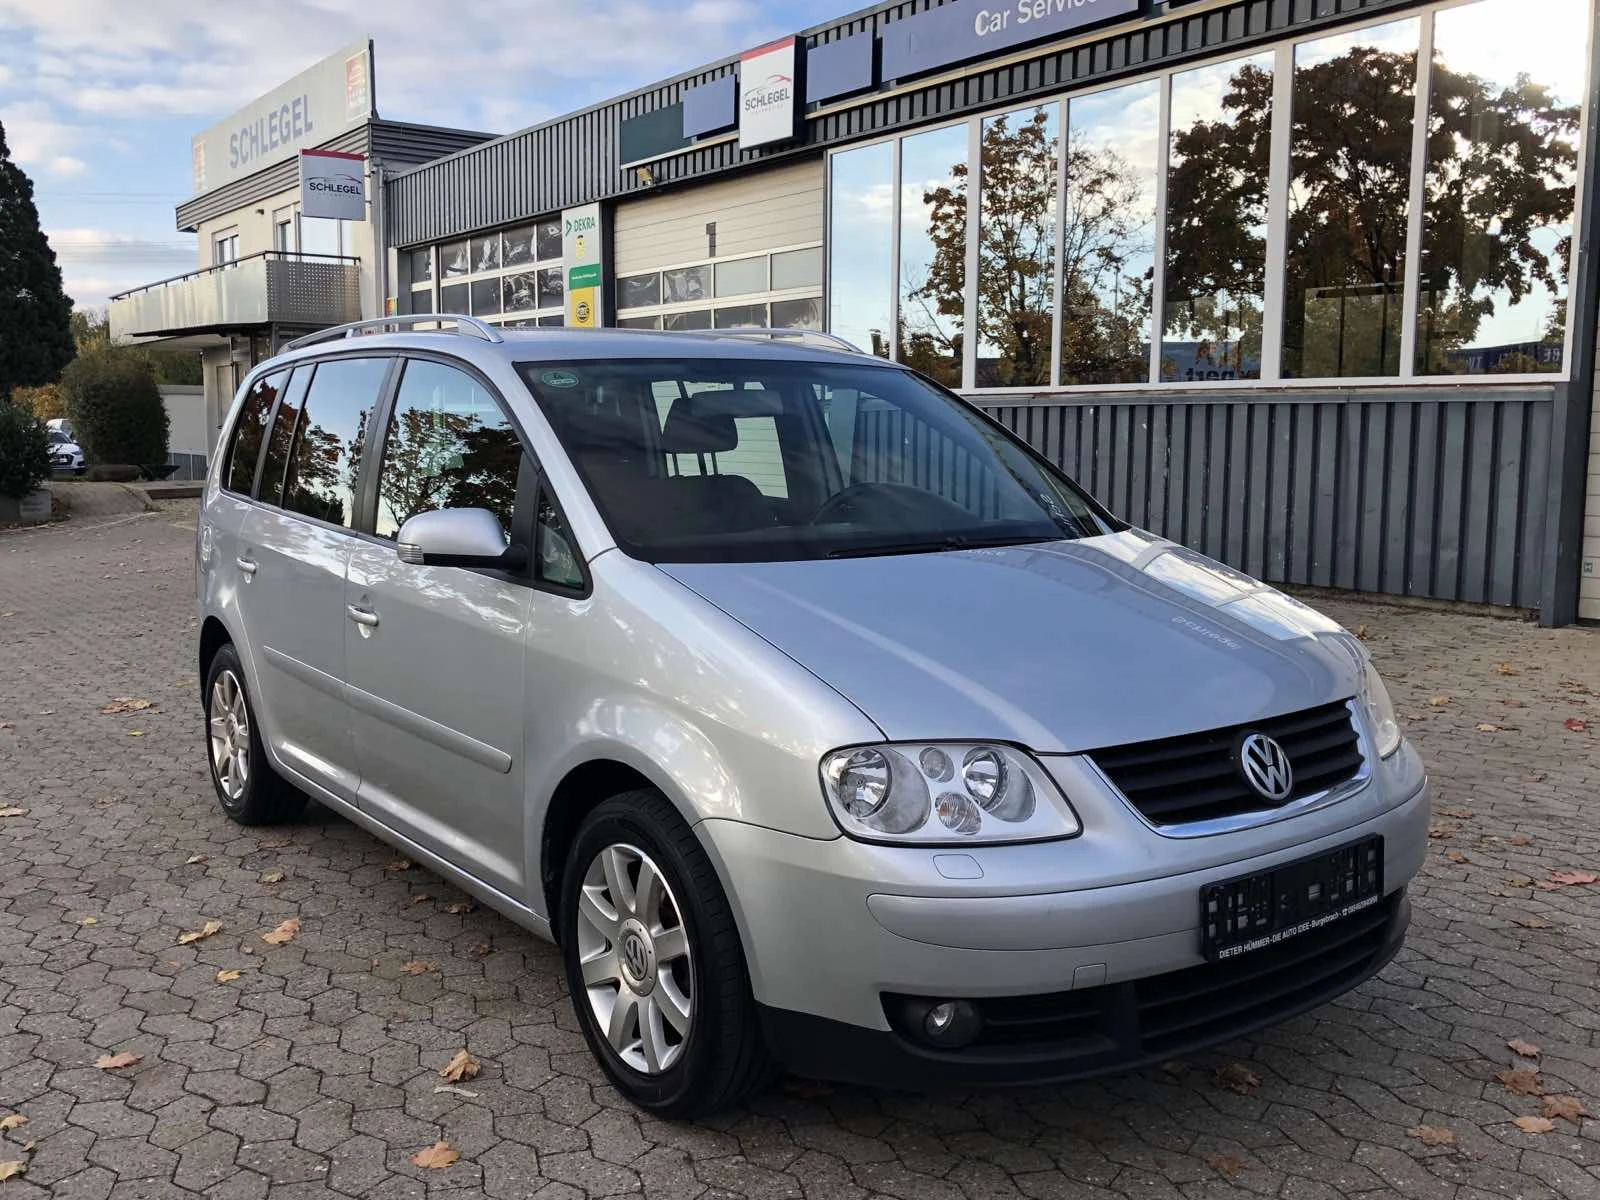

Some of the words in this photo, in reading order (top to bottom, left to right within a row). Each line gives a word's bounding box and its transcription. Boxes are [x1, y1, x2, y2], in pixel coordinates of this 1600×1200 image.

[975, 10, 1010, 36] Car
[1017, 0, 1097, 24] Servi
[744, 88, 790, 111] SCHLEGEL
[229, 94, 313, 169] SCHLEGEL
[309, 182, 362, 195] SCHLEGEL
[574, 217, 596, 232] DEKRA
[1219, 945, 1242, 959] DIETER
[1282, 926, 1297, 939] AUTO
